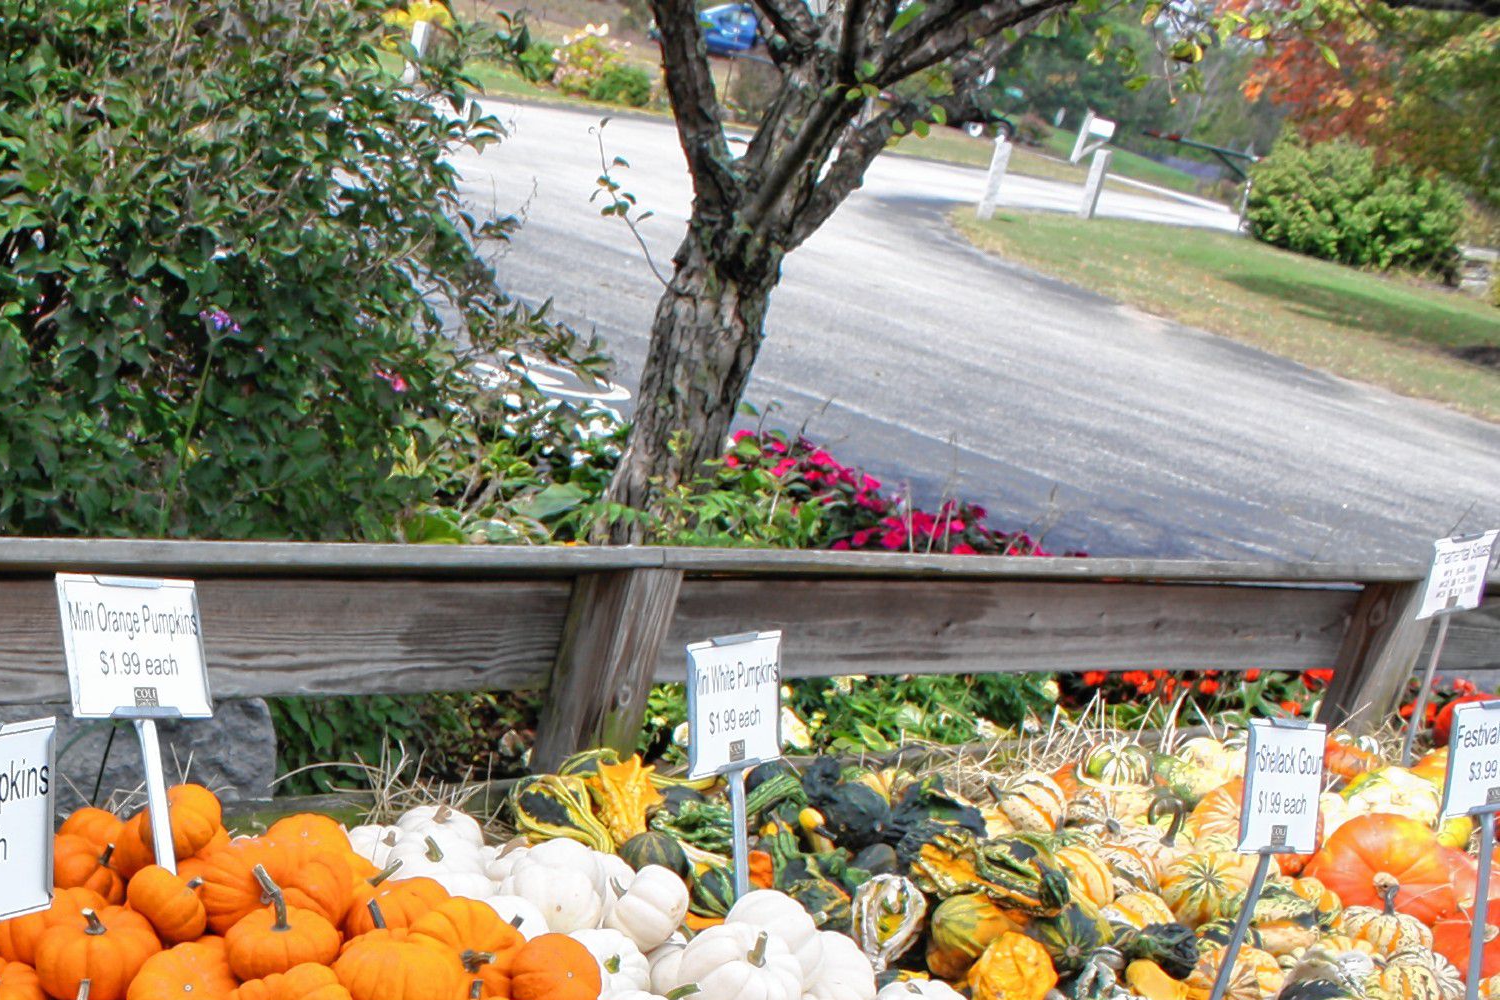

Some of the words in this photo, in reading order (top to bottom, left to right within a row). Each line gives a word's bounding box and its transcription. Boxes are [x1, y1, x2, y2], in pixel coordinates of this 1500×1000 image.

[68, 601, 94, 631] Mini
[97, 602, 140, 640] Orange
[142, 604, 198, 641] Pumpkins
[100, 650, 141, 675] $1.99
[146, 653, 179, 675] each
[711, 664, 734, 692] White
[738, 656, 779, 692] Pumpkins
[709, 709, 736, 735] $1.99
[739, 704, 761, 728] each
[1469, 760, 1497, 781] $3.99
[1284, 792, 1307, 814] each
